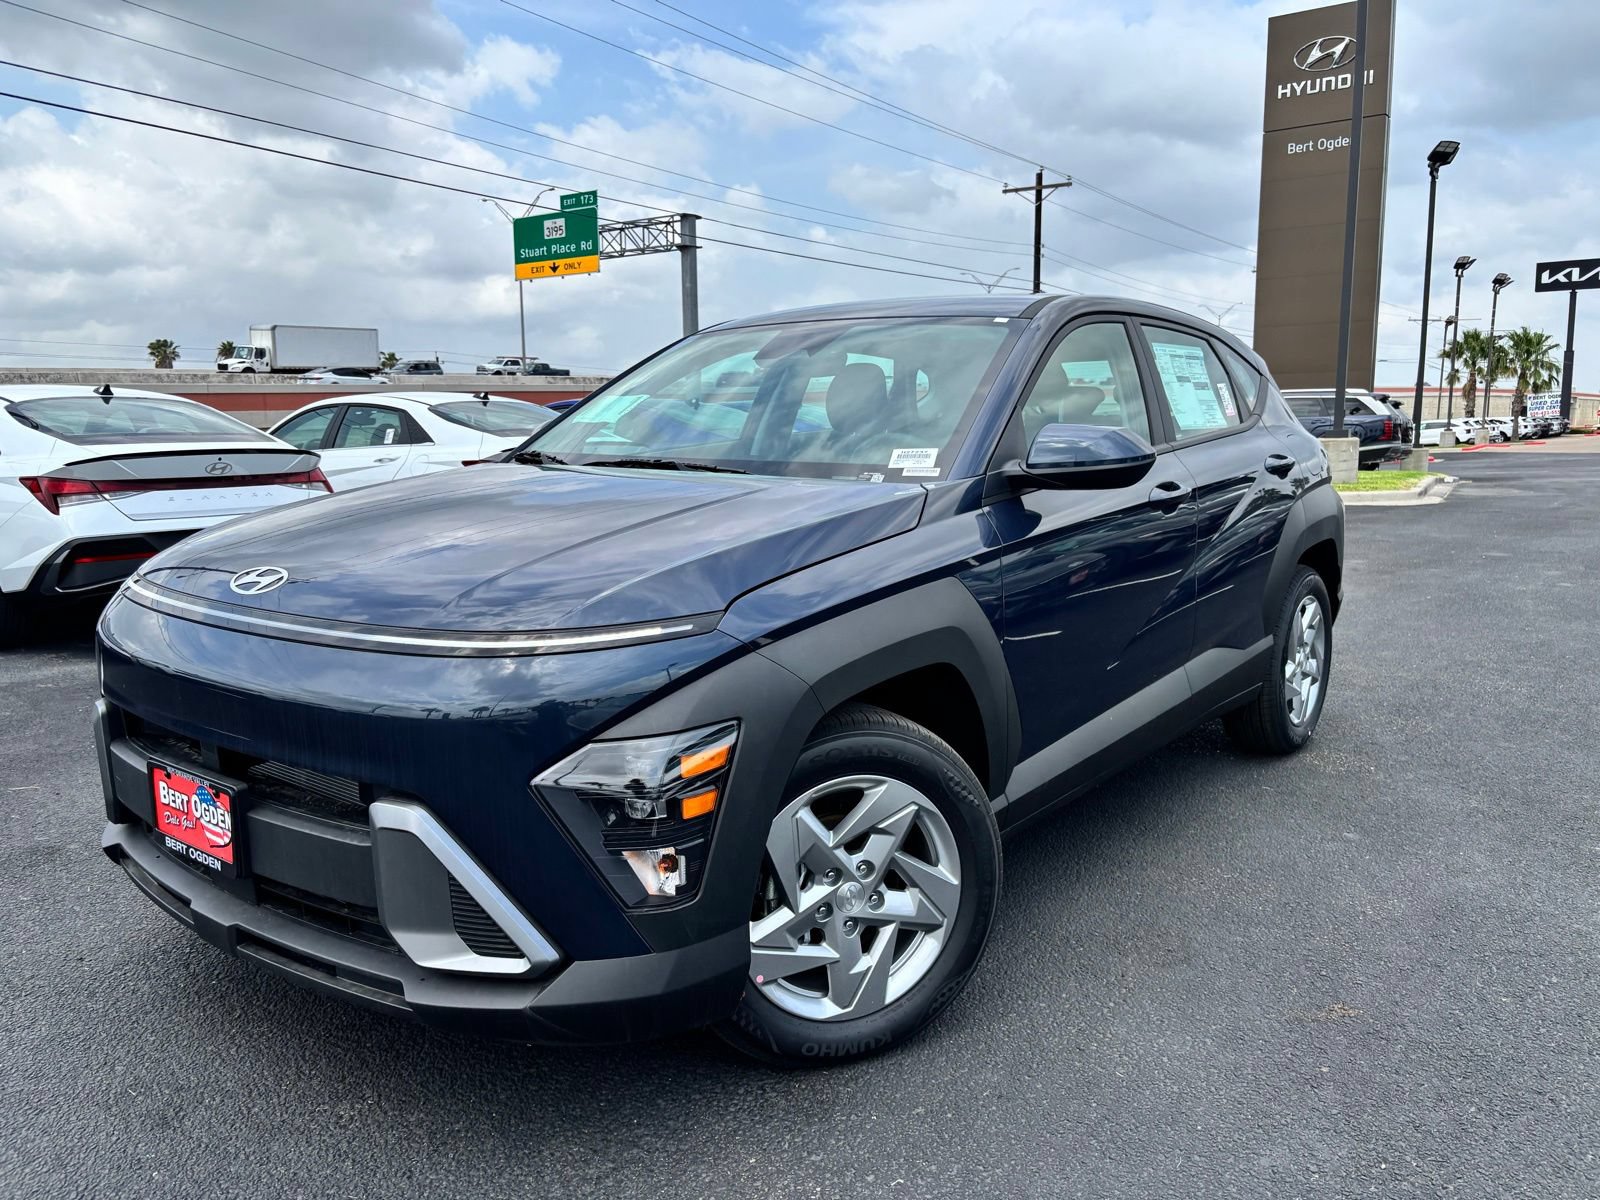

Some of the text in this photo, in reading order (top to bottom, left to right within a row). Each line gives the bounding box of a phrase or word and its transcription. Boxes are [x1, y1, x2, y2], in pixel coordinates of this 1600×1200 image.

[1277, 69, 1374, 99] HYUNDI
[1287, 136, 1352, 154] Bert Ogde
[563, 195, 594, 206] EXIT 173
[545, 225, 564, 238] 3195
[520, 240, 593, 258] Stuart Place Rd
[531, 262, 582, 274] EXIT ONLY
[159, 781, 231, 832] BERT OGDEN
[165, 836, 222, 871] BERT OGDEN
[801, 1031, 892, 1057] KUMHO
